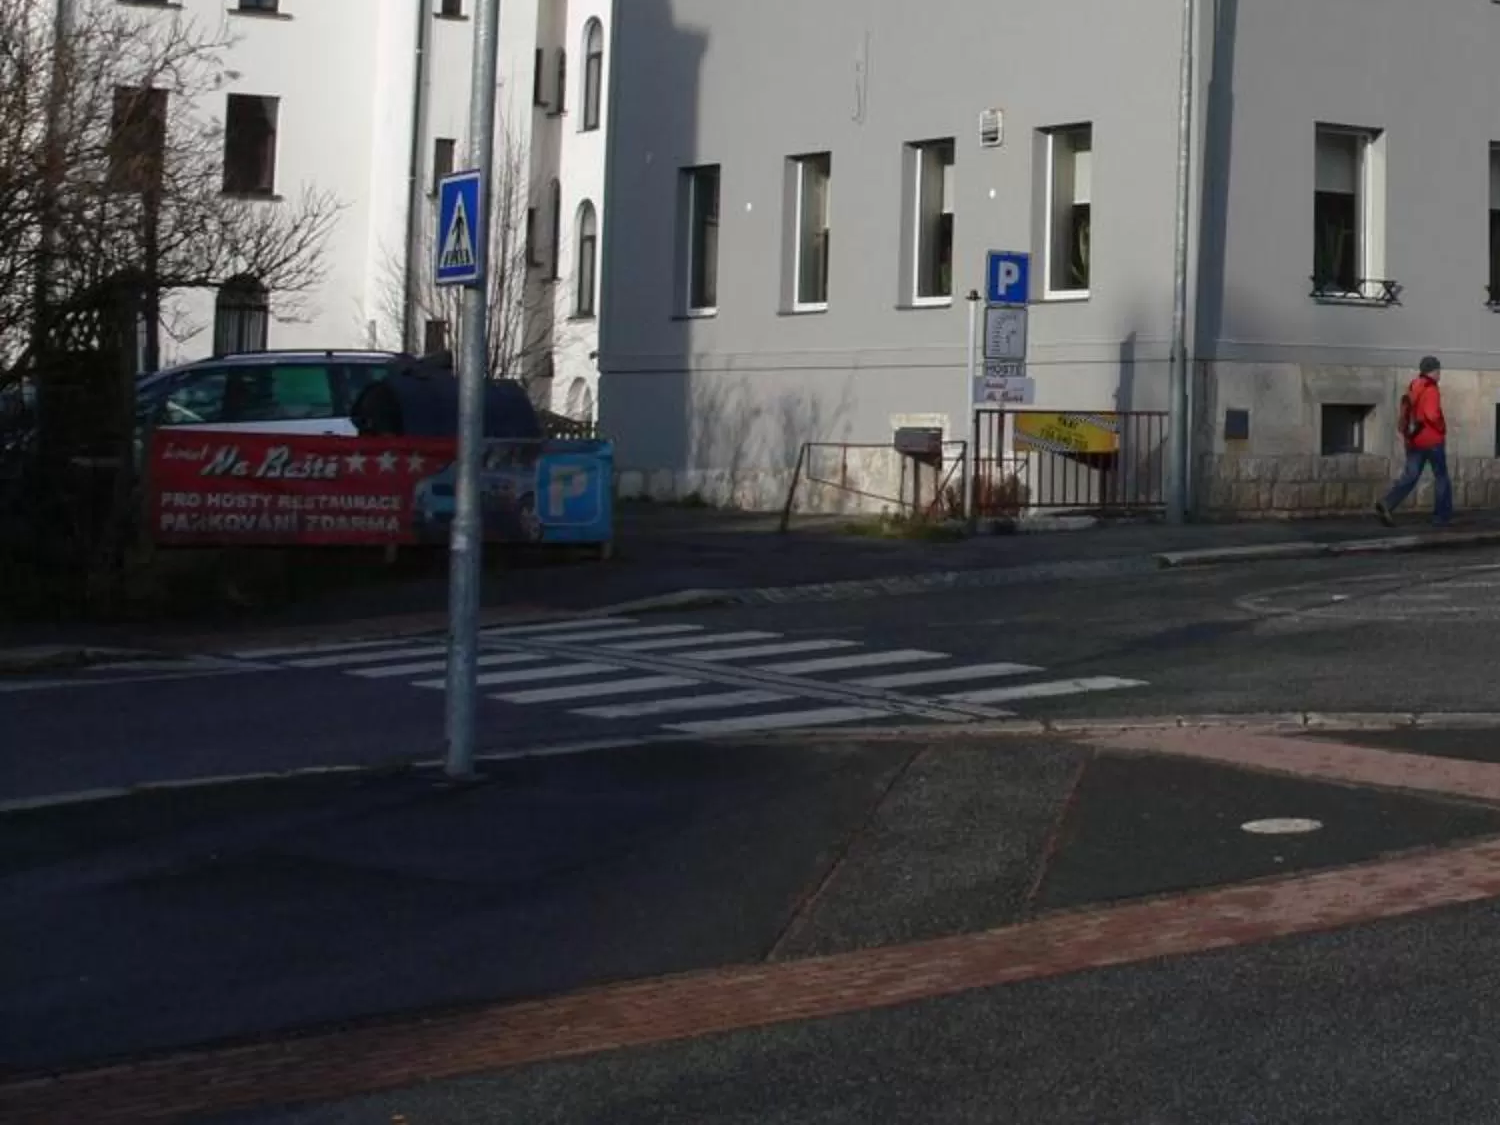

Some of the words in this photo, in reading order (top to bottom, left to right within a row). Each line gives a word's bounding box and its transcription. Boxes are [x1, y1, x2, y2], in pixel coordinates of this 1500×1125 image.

[998, 260, 1020, 295] P
[160, 492, 201, 508] PRO
[206, 492, 273, 509] HOSTY
[277, 494, 402, 511] RESTAURACE
[549, 465, 589, 516] P
[305, 514, 401, 532] ZDARMA
